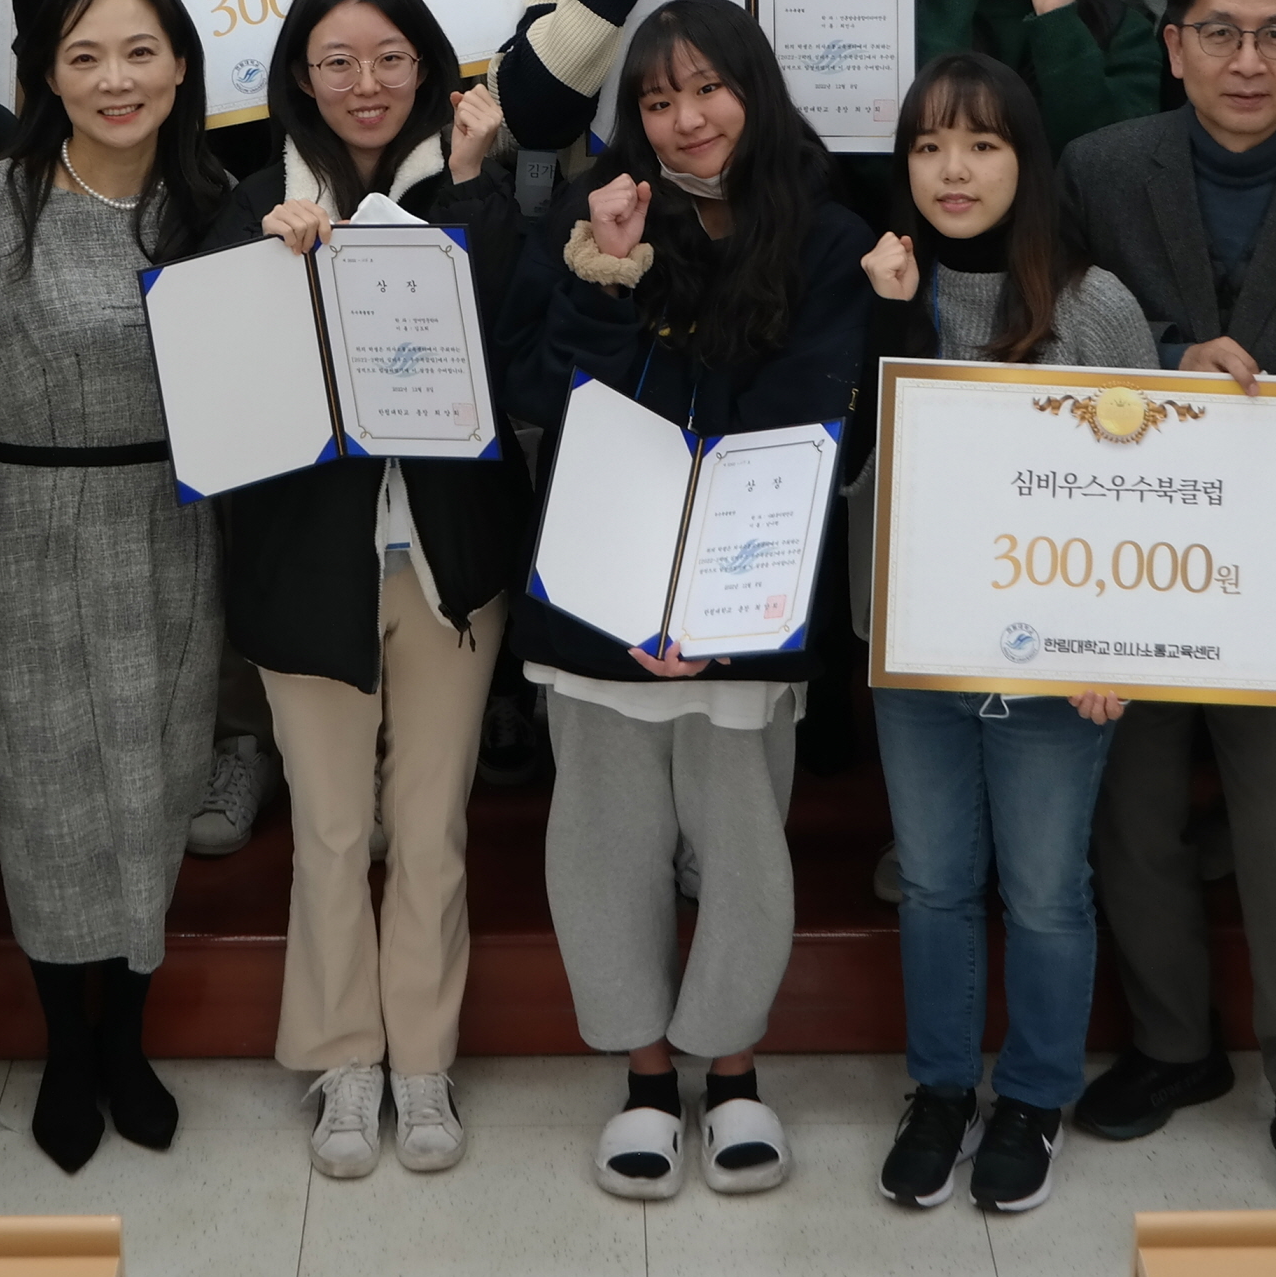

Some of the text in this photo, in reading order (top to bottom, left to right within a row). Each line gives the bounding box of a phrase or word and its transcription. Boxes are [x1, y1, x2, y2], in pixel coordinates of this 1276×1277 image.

[376, 279, 417, 293] 상 장
[1010, 468, 1225, 507] 심비우스우수북클럽
[990, 533, 1242, 597] 300,000원
[1043, 637, 1111, 656] 한림대학교
[1112, 640, 1222, 661] 의사소통교육센터
